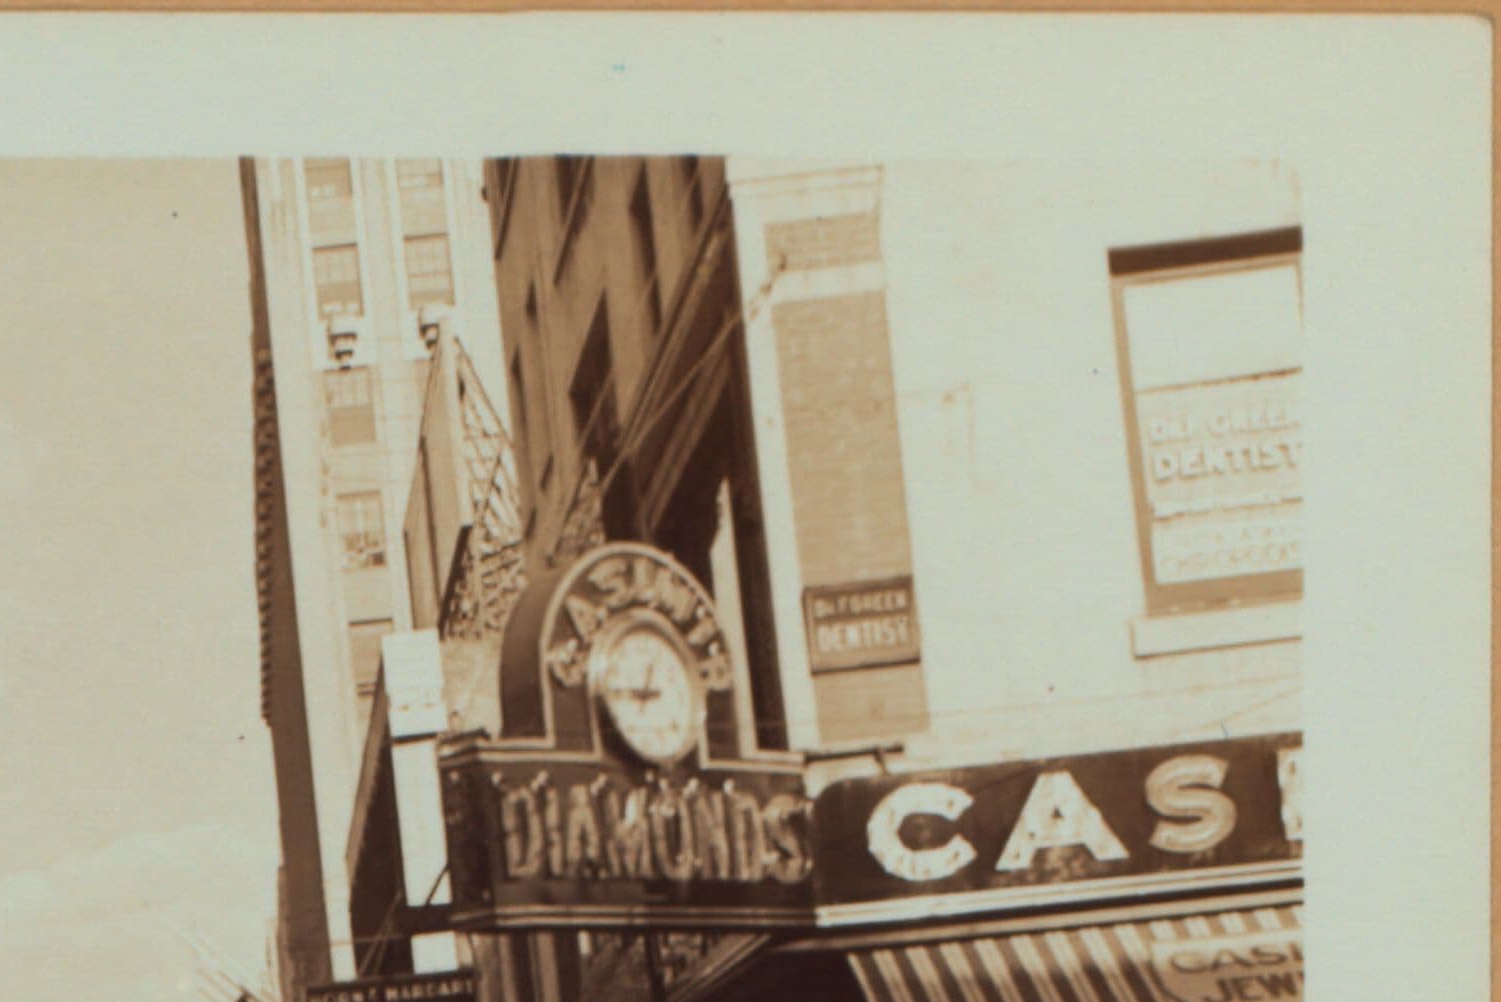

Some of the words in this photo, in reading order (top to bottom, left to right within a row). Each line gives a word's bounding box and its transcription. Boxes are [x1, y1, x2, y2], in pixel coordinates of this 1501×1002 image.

[1152, 440, 1301, 483] DENTIST
[817, 616, 907, 652] DENTIST
[502, 786, 811, 884] DIAMONDS
